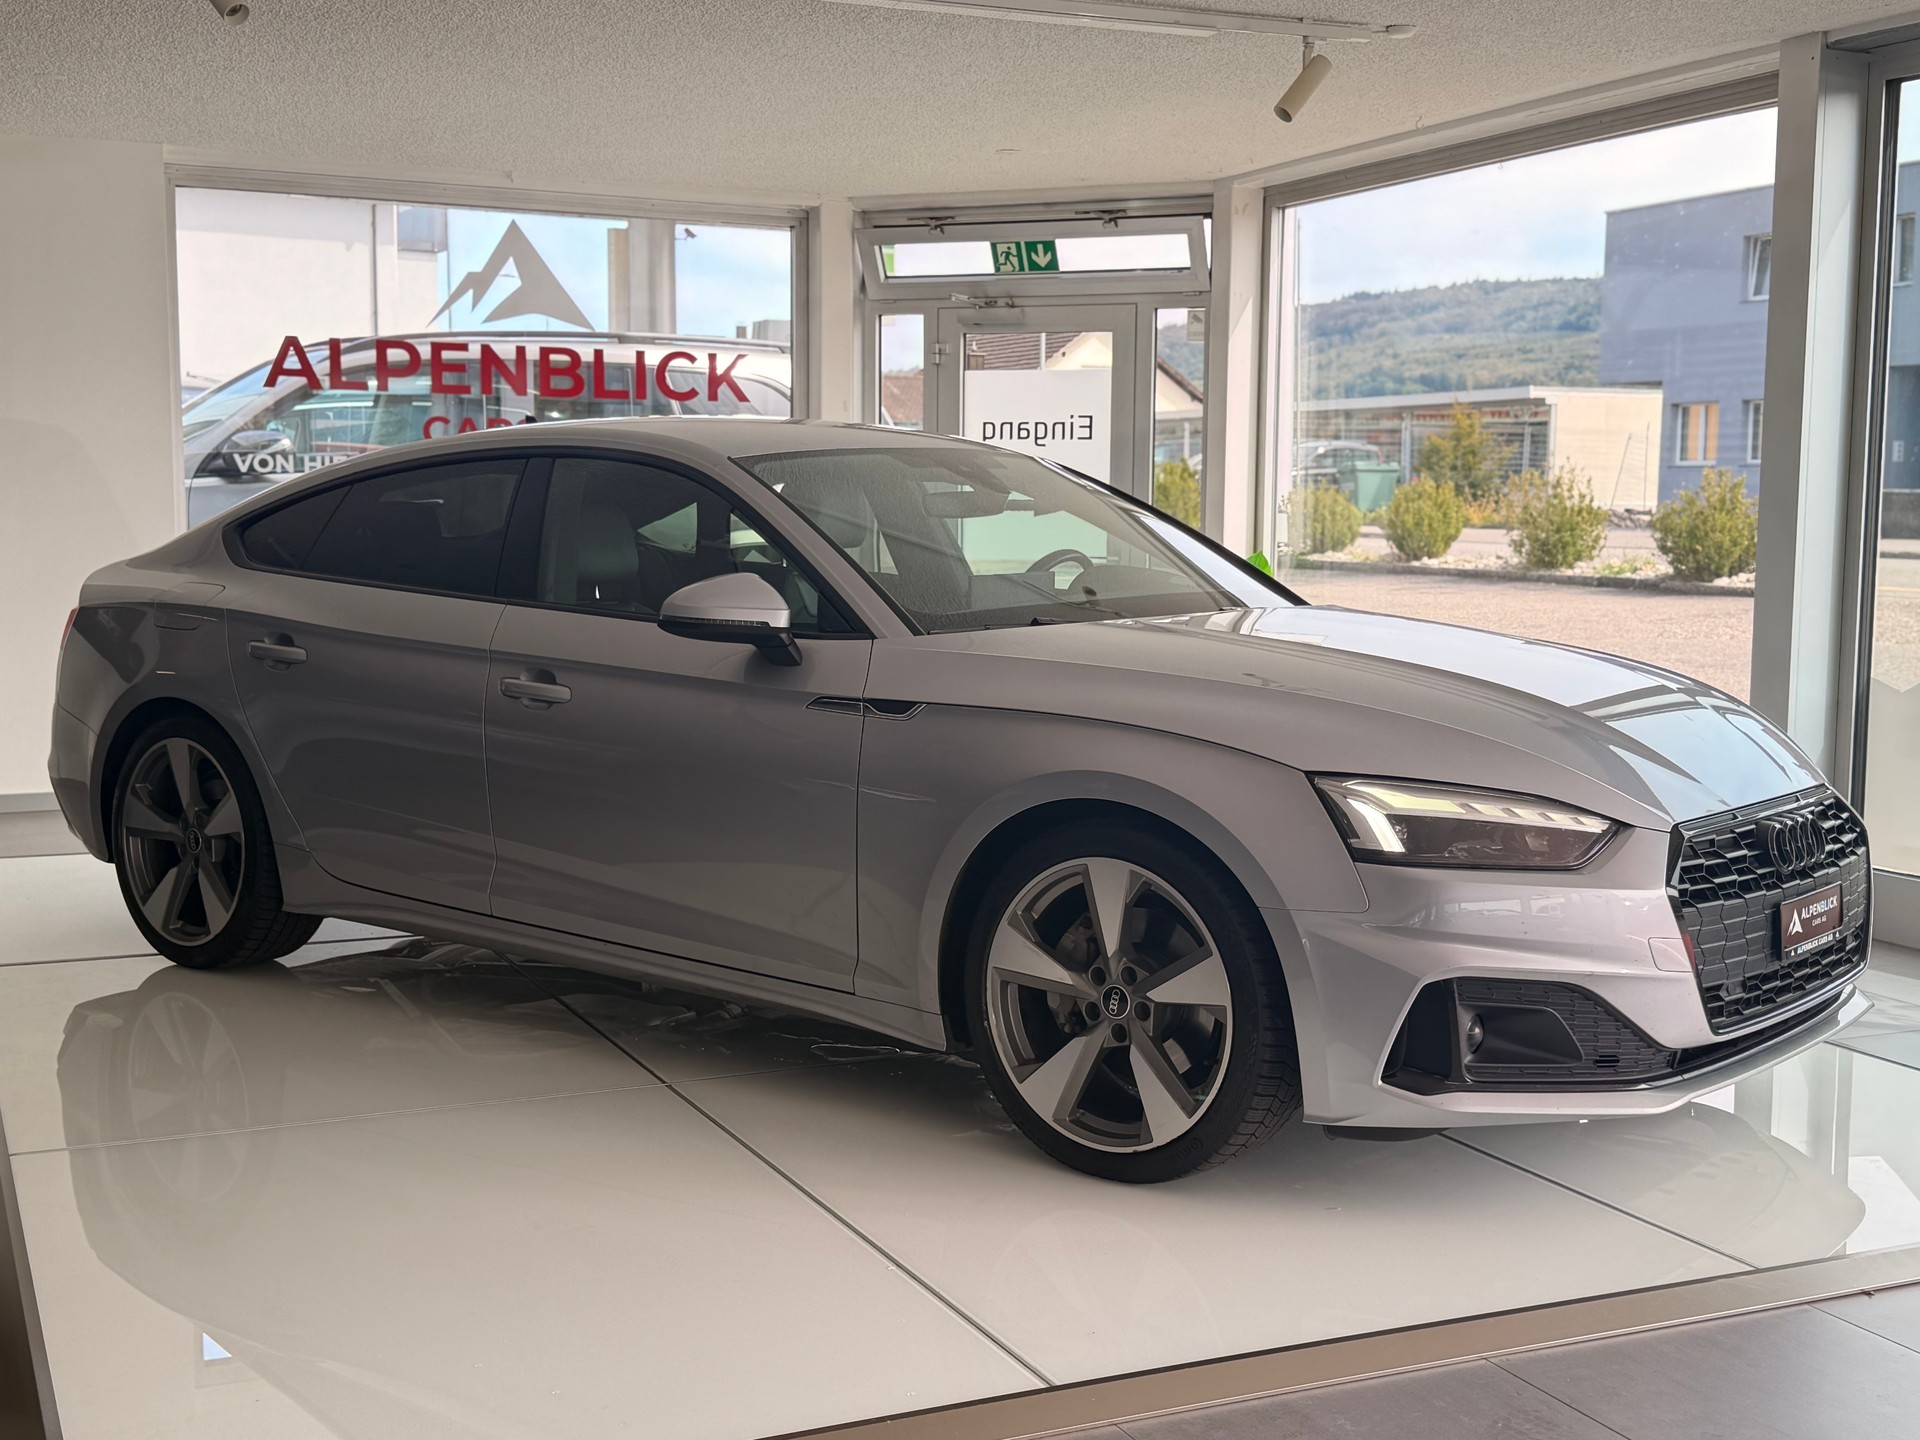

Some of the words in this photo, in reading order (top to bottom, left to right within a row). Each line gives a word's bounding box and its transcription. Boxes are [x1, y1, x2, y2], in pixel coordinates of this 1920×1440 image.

[263, 335, 751, 403] ALPENBLICK
[233, 453, 294, 473] VON
[1801, 895, 1838, 919] ALPENBLICK
